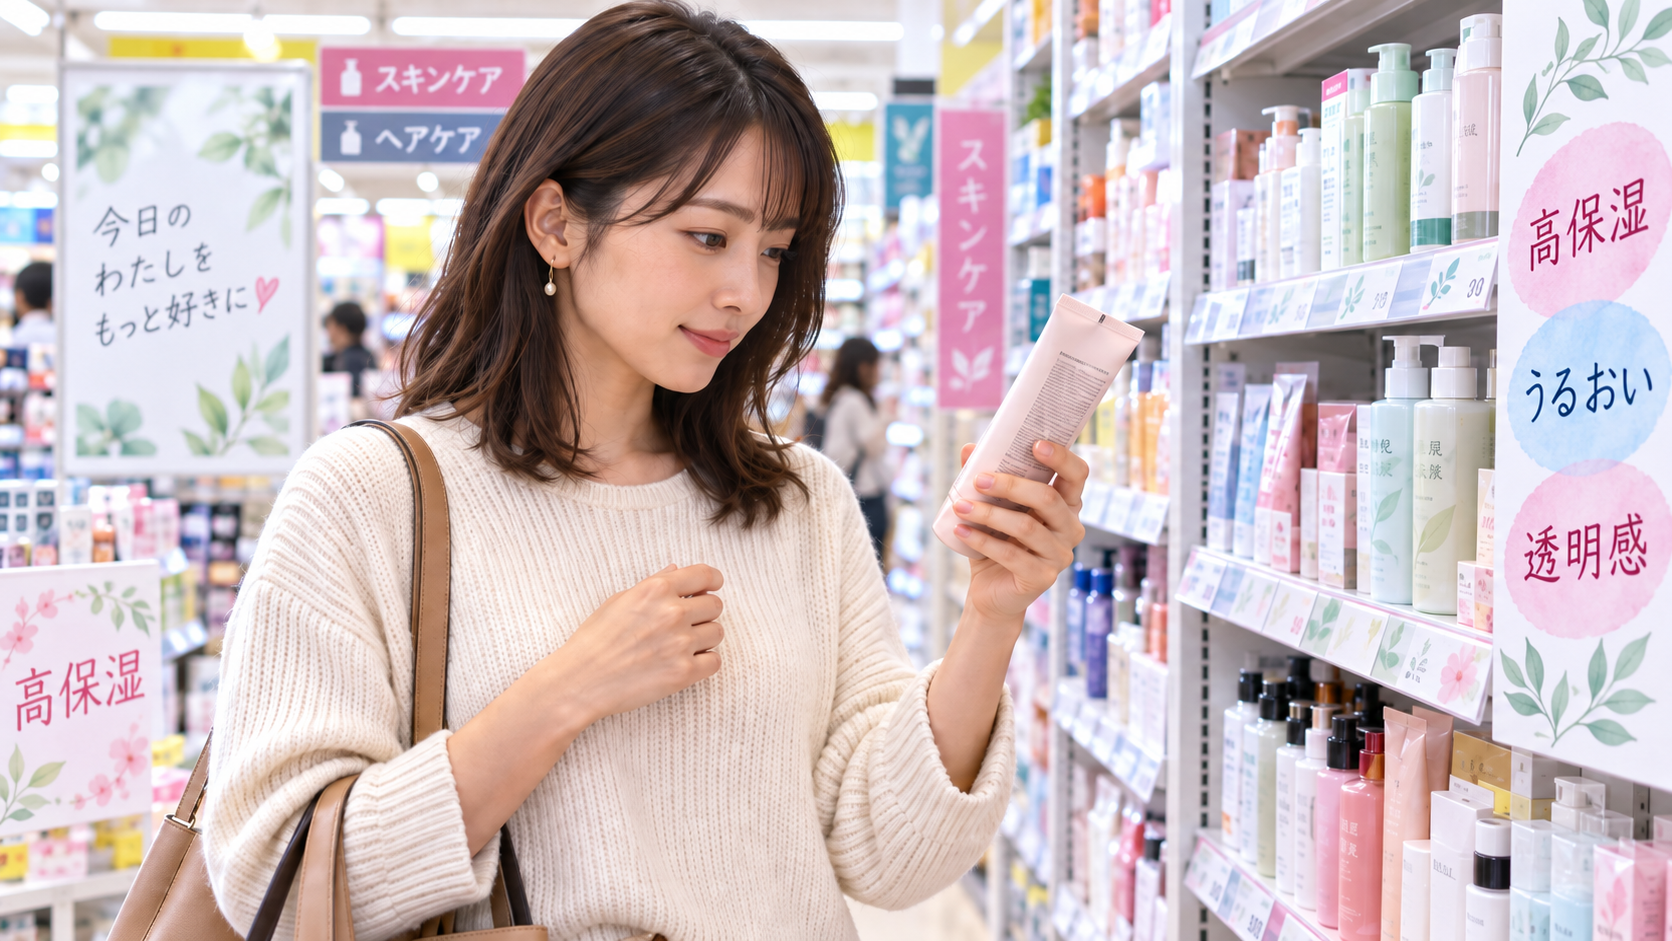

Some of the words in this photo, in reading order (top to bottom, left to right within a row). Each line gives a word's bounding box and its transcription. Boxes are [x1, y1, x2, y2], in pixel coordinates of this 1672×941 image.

[375, 63, 504, 95] スキンケア
[375, 124, 482, 154] ヘアケア
[93, 203, 192, 248] 今日の
[957, 138, 988, 334] スキンケア
[1529, 178, 1649, 272] 高保湿
[94, 242, 213, 297] わたしを
[95, 285, 248, 347] もっと好きに
[1525, 361, 1653, 423] うるおい
[1523, 512, 1647, 583] 透明感
[15, 649, 145, 732] 高保湿
